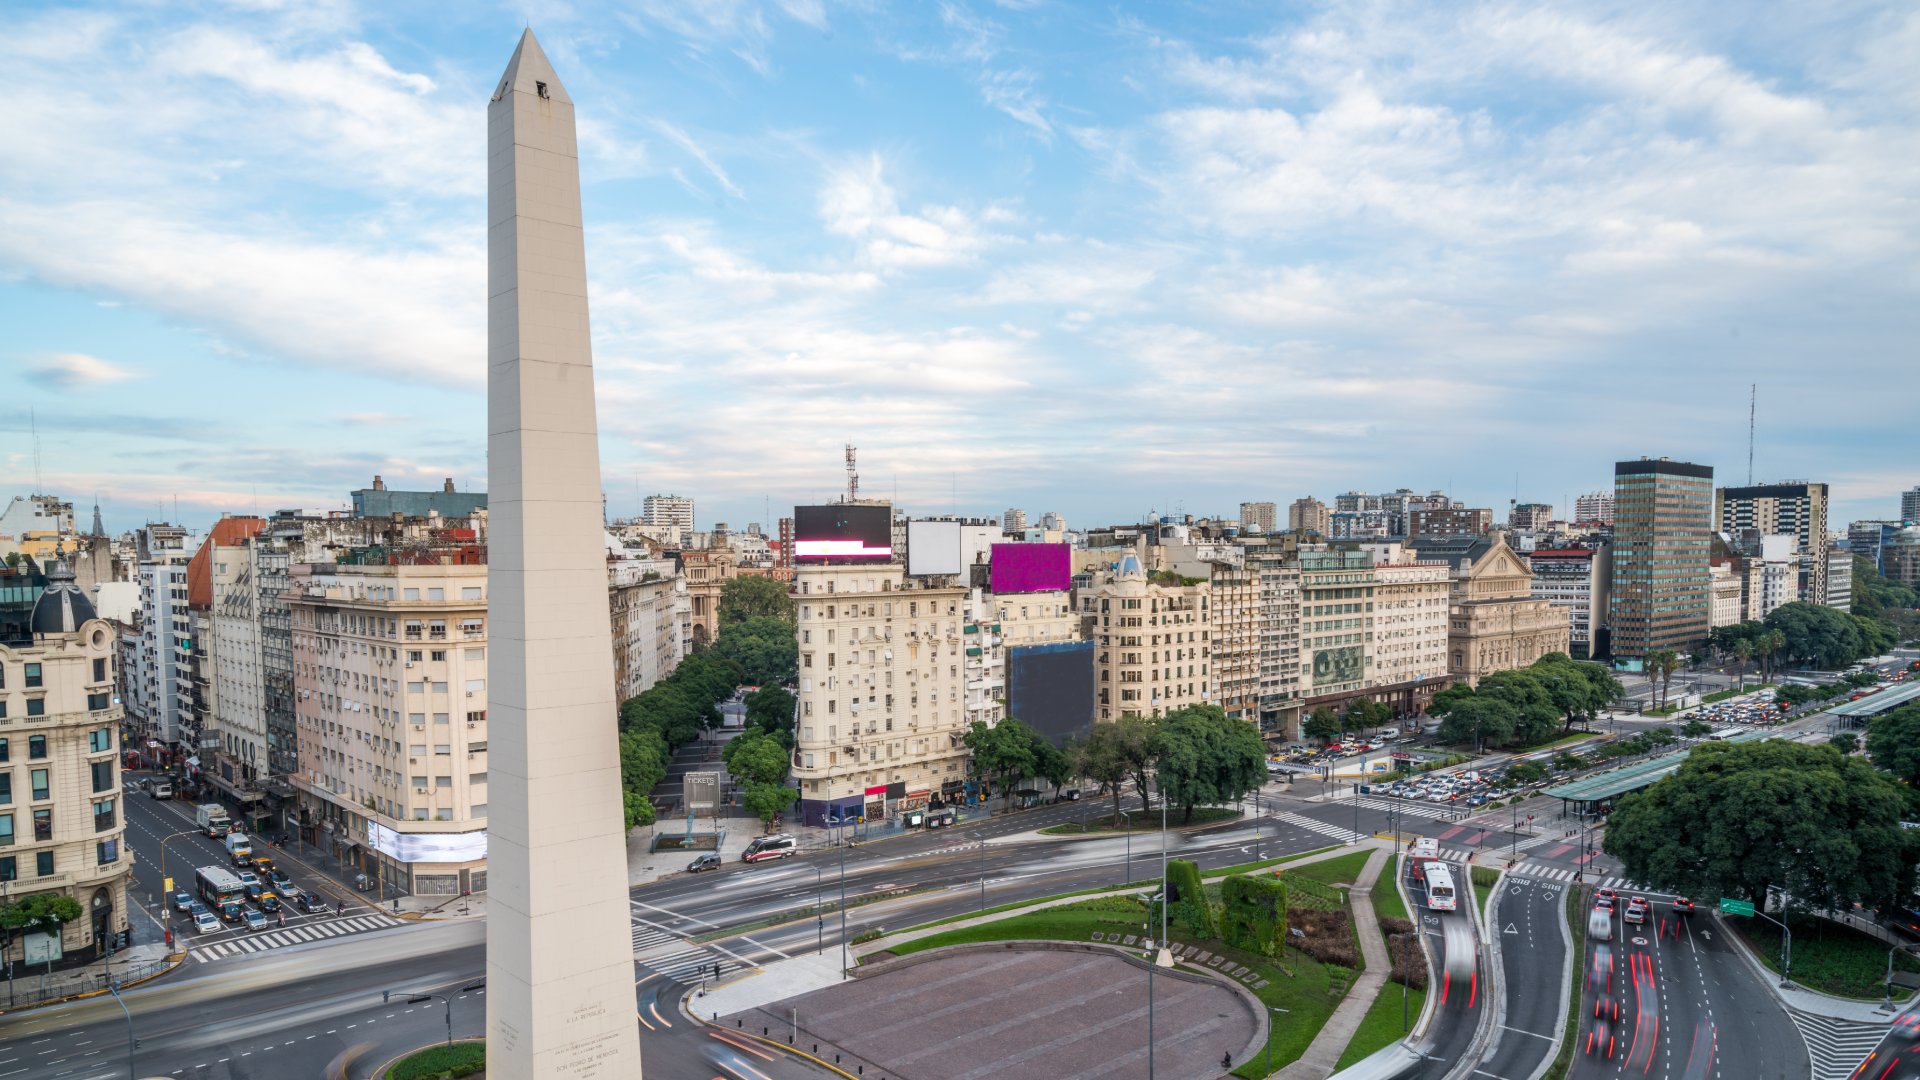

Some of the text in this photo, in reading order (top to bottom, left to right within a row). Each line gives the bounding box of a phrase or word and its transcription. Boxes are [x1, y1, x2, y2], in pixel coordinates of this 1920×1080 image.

[1510, 877, 1531, 886] BUS
[1541, 882, 1562, 892] BUS
[1424, 915, 1439, 925] 59
